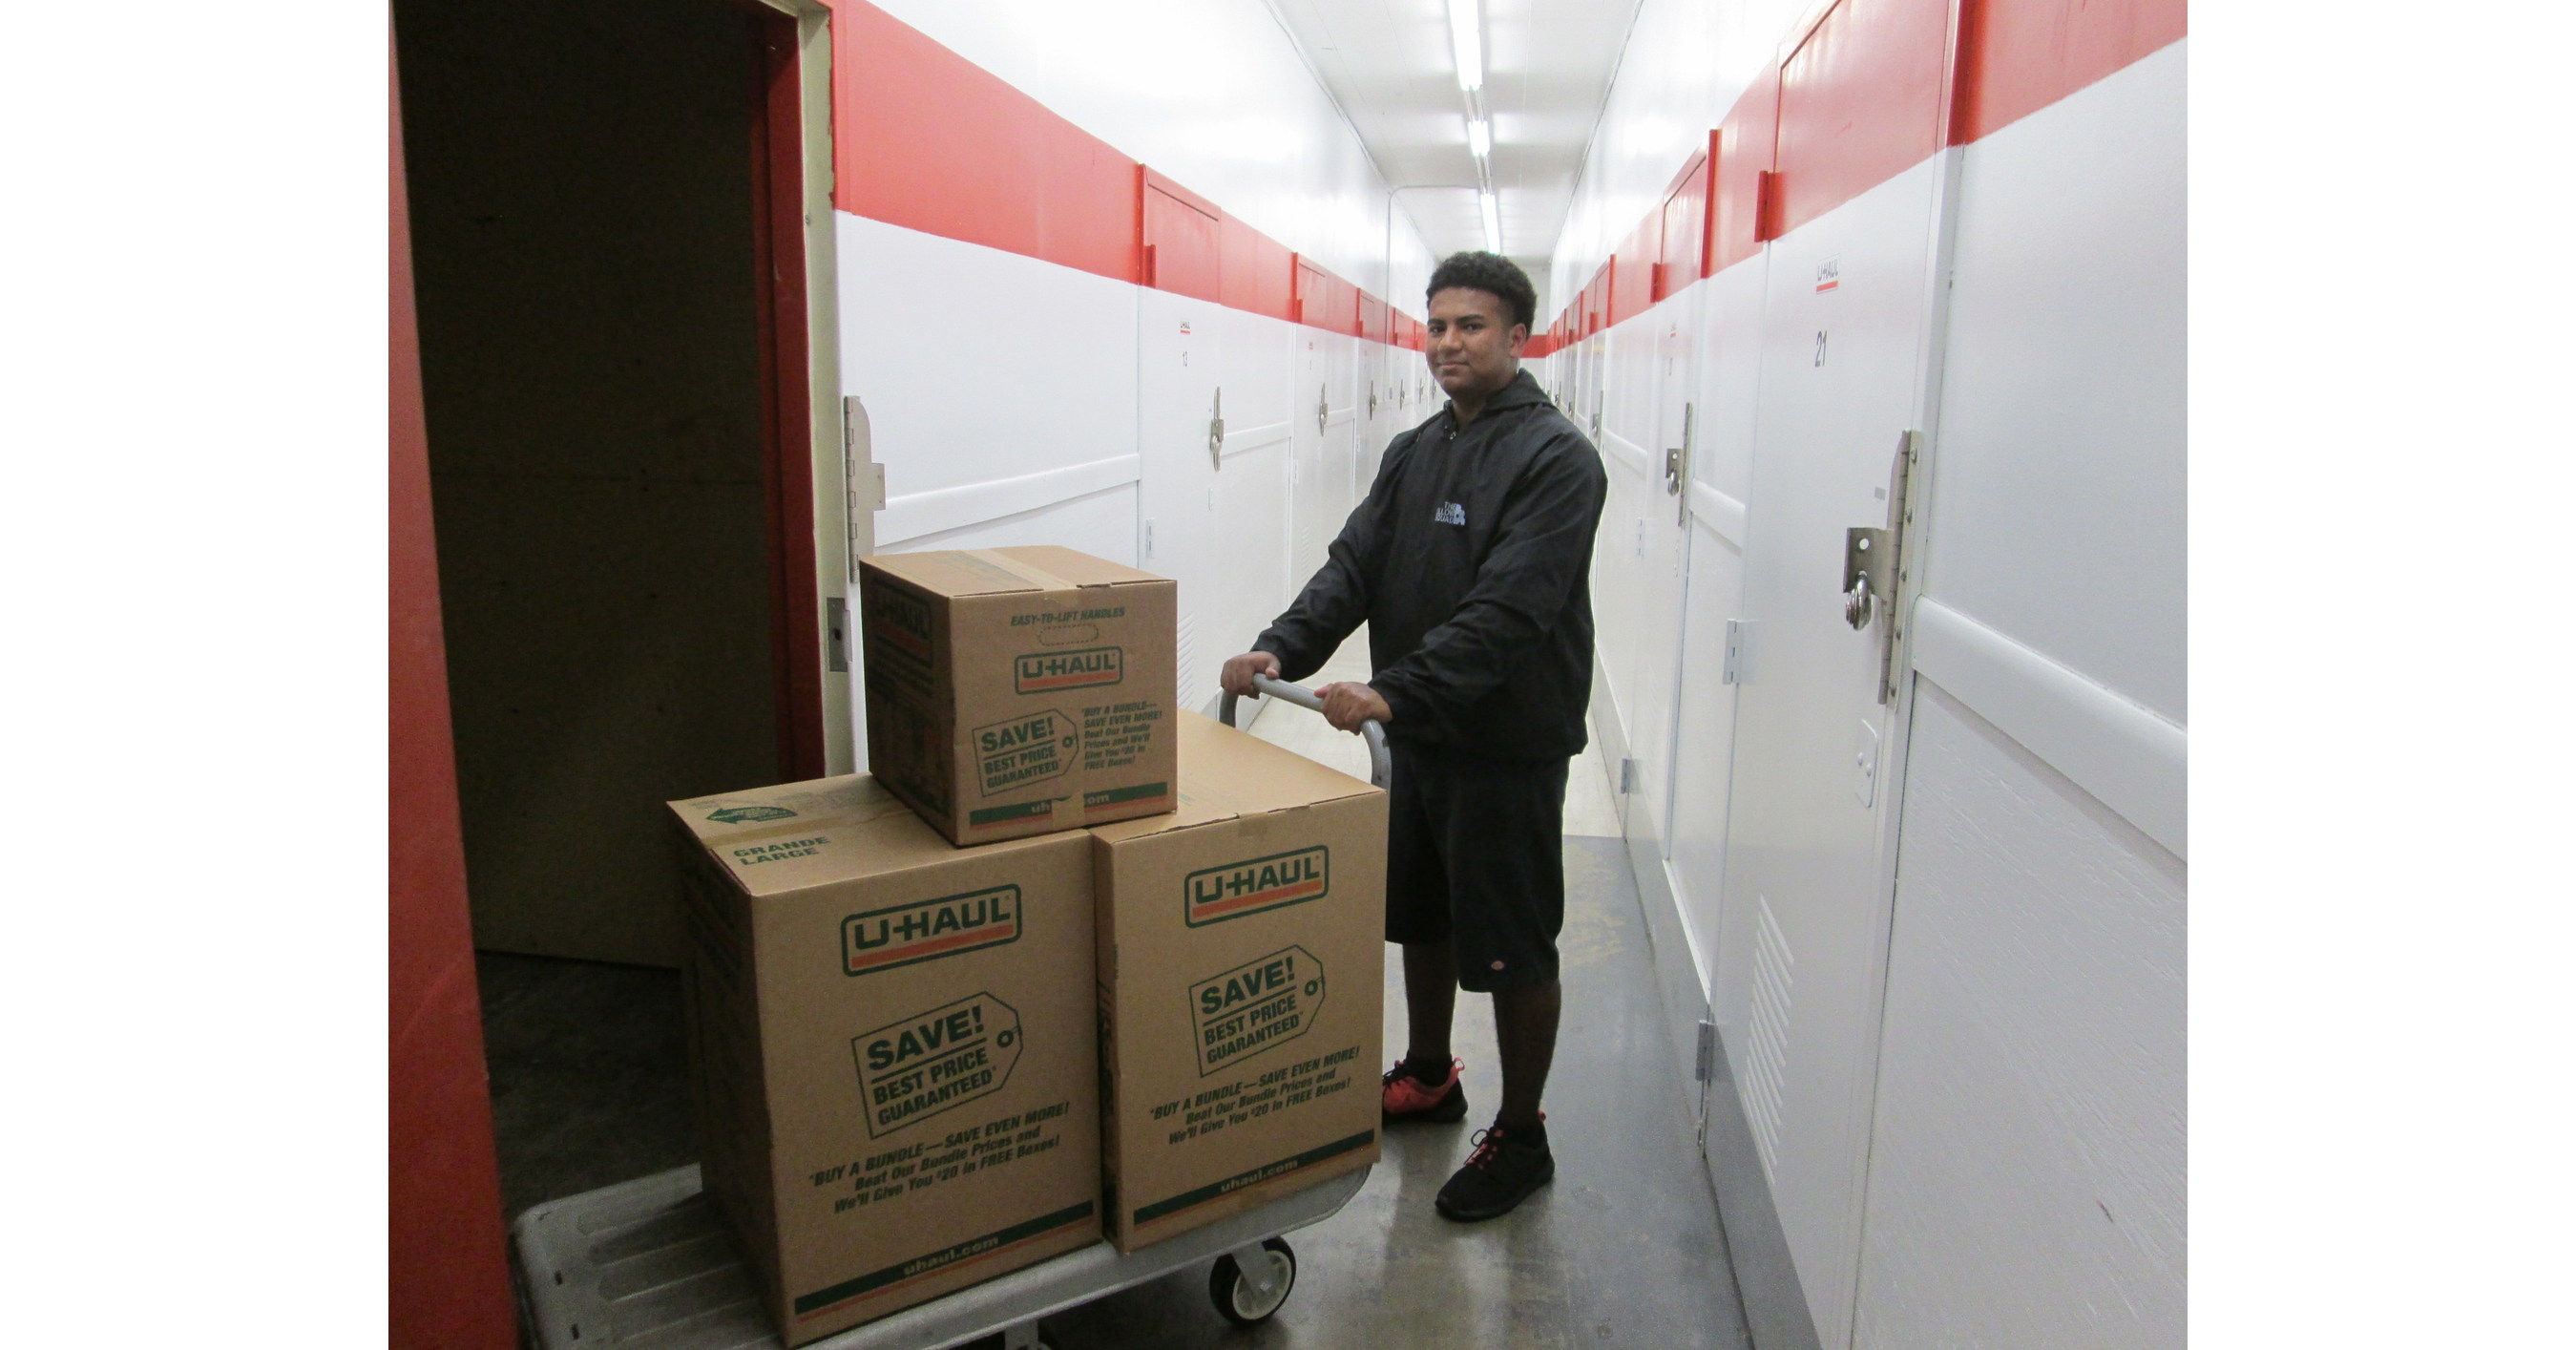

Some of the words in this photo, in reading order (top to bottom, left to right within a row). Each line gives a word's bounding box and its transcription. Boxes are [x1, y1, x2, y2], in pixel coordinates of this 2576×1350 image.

[1815, 329, 1827, 368] 21
[1022, 654, 1116, 678] U-HAUL
[981, 717, 1055, 751] SAVE!
[1084, 717, 1106, 728] SAVE
[1109, 714, 1131, 725] EVEN
[1104, 706, 1110, 714] A
[984, 756, 1016, 774] BEST
[1019, 746, 1056, 765] PRICE
[734, 836, 830, 856] GRANDE
[740, 848, 819, 865] LARGE
[1195, 856, 1320, 903] U-HAUL
[854, 896, 1011, 950] U-HAUL
[1201, 956, 1295, 1014] SAVE!
[868, 1005, 984, 1071] SAVE!
[1204, 1018, 1245, 1045] BEST
[1250, 995, 1297, 1028] PRICE
[873, 1070, 923, 1105] BEST
[931, 1047, 989, 1084] PRICE
[1183, 1098, 1191, 1110] A
[1291, 1058, 1321, 1077] EVEN
[1324, 1045, 1360, 1067] MORE!
[1185, 1107, 1213, 1125] Beat
[1215, 1101, 1236, 1115] Our
[1239, 1088, 1277, 1107] Bundle
[1280, 1077, 1312, 1095] Prices
[1316, 1068, 1336, 1084] and
[1169, 1125, 1197, 1145] We'll
[1200, 1119, 1225, 1135] Give
[1228, 1111, 1248, 1126] You
[1272, 1100, 1283, 1111] in
[1287, 1089, 1313, 1107] FREE
[1316, 1077, 1351, 1098] Boxes!
[849, 1162, 860, 1176] A
[985, 1115, 1021, 1137] EVEN
[1025, 1101, 1070, 1125] MORE!
[855, 1170, 888, 1192] Beat
[891, 1165, 916, 1180] Our
[920, 1148, 968, 1171] Bundle
[972, 1136, 1012, 1156] Prices
[1016, 1125, 1040, 1143] and
[834, 1192, 869, 1213] We'll
[873, 1185, 904, 1201] Give
[909, 1175, 933, 1192] You
[963, 1161, 976, 1174] in
[980, 1149, 1014, 1170] FREE
[1016, 1134, 1060, 1158] Boxes!
[1220, 1158, 1298, 1193] uhaul.com
[904, 1236, 1000, 1276] uhaul.com
